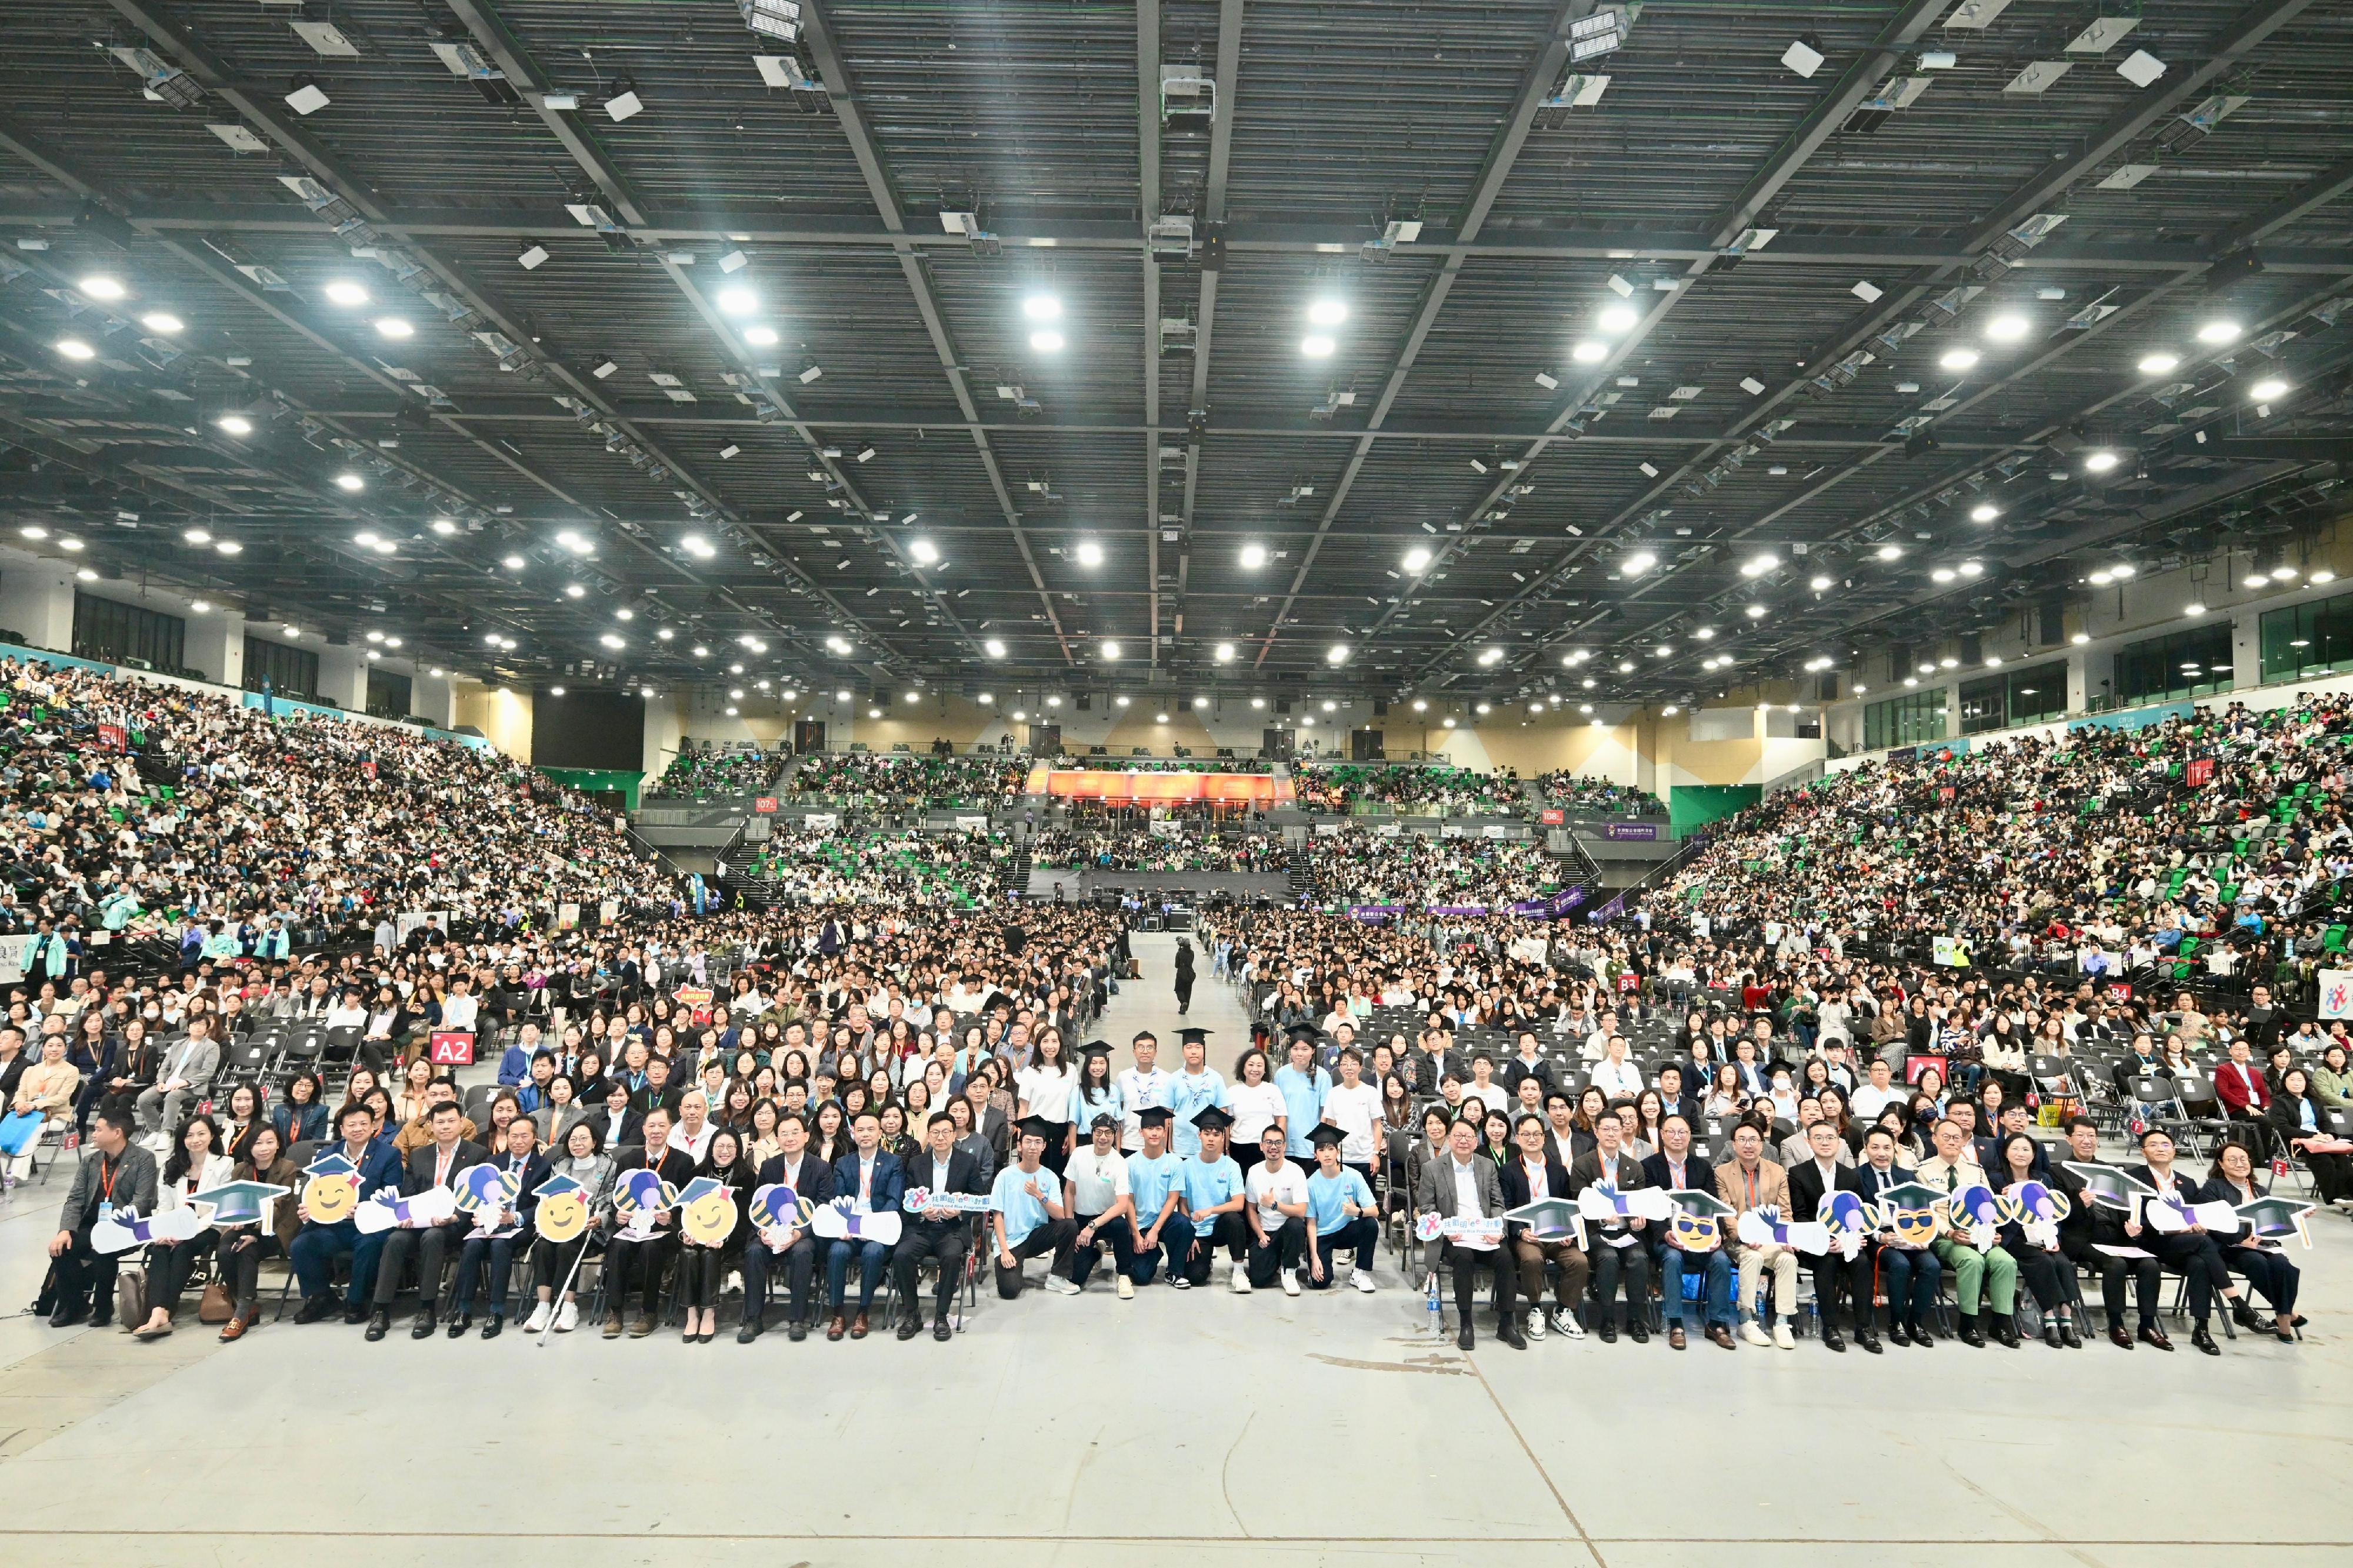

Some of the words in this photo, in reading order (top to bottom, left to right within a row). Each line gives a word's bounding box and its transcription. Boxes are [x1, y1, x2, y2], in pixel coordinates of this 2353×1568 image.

[1621, 979, 1636, 990] B3
[2112, 988, 2128, 999] B4
[436, 1040, 467, 1060] A2
[2029, 1097, 2034, 1106] H
[202, 1106, 208, 1115] F
[68, 1137, 74, 1147] E
[2276, 1163, 2282, 1175] E
